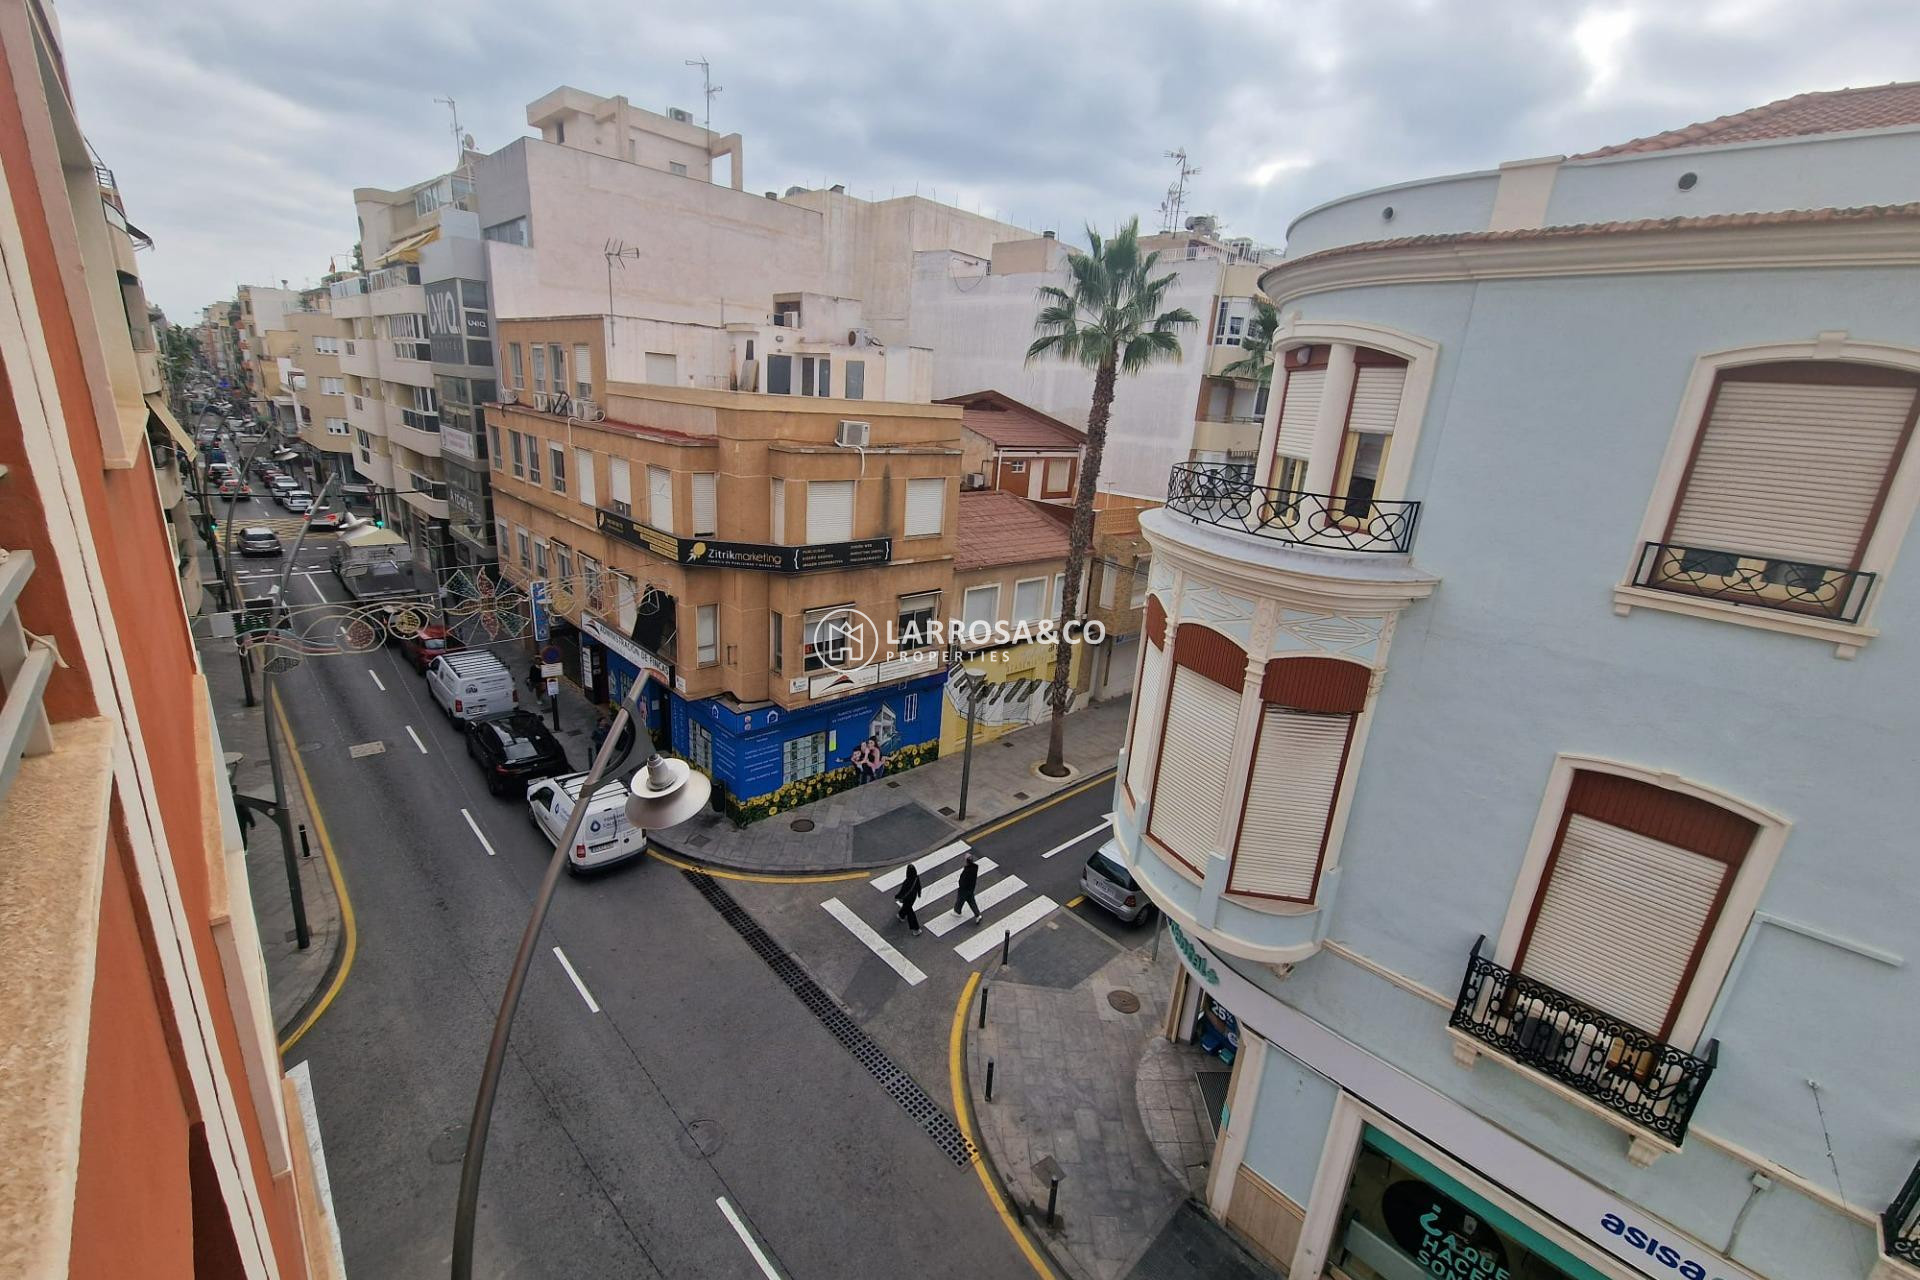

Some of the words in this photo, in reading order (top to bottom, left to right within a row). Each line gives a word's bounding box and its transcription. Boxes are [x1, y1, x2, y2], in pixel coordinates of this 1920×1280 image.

[708, 548, 782, 565] Zitrikmarketing
[1422, 1234, 1496, 1280] HACE
[1600, 1213, 1706, 1280] asisa
